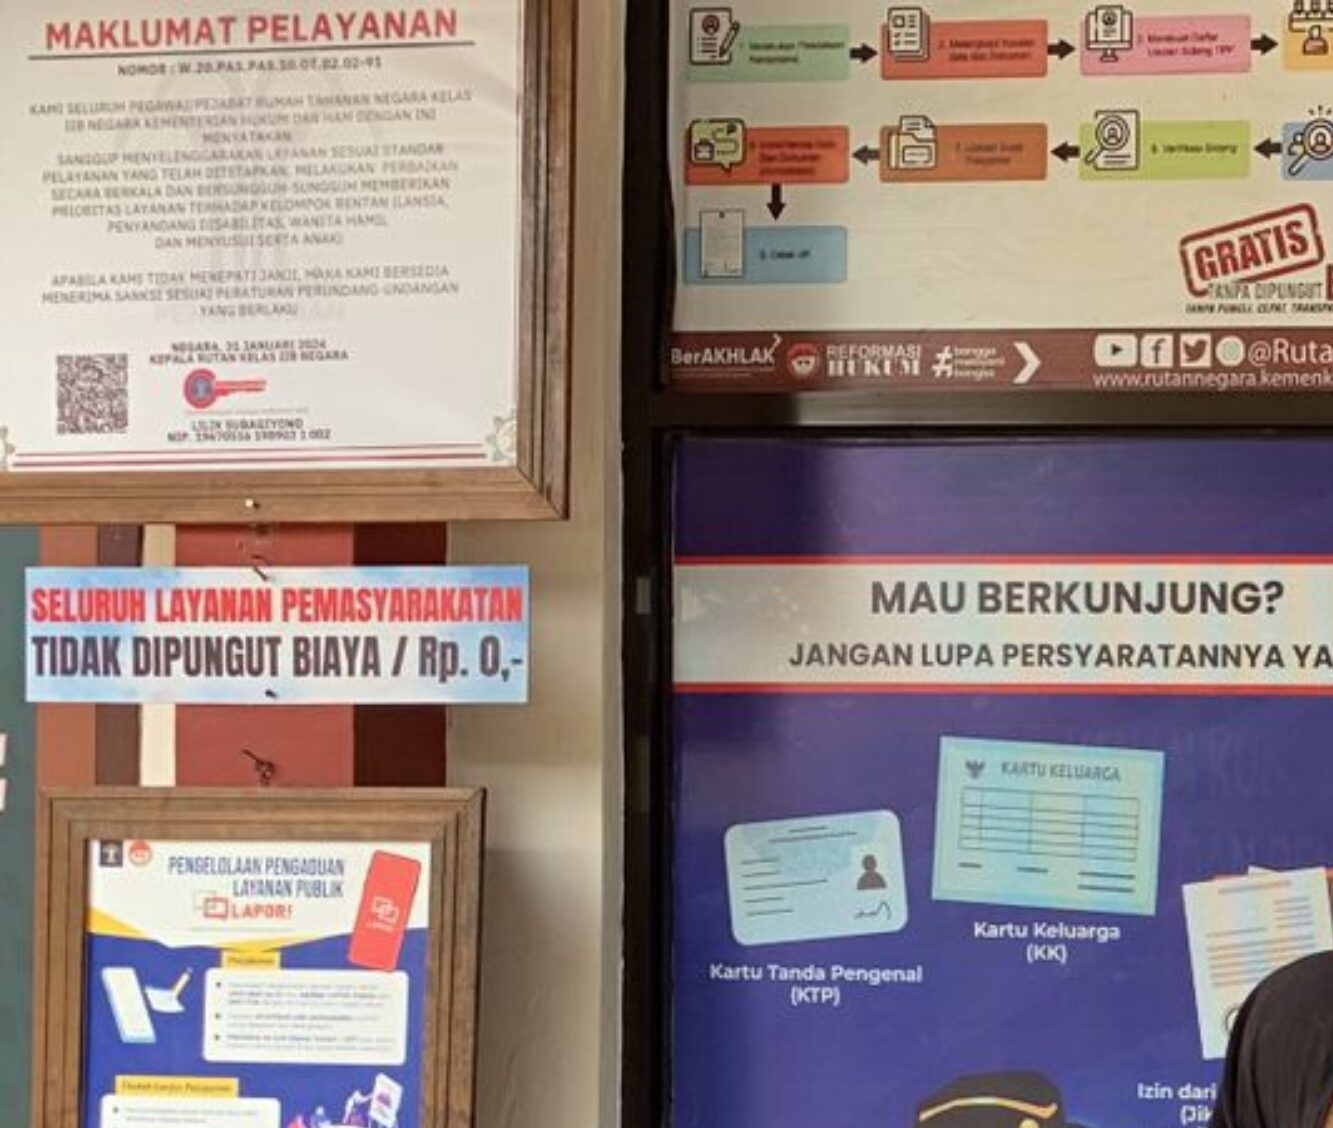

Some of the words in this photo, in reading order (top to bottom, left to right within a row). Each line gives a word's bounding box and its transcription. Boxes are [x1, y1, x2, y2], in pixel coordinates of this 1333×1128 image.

[47, 16, 236, 49] MAKLUMAT
[248, 10, 456, 43] PELAYANAN
[1194, 219, 1310, 282] GRATIS
[1256, 283, 1322, 298] DIPUNGUT
[671, 347, 775, 365] BerAKHLAK
[826, 344, 921, 361] REFORMASI
[32, 588, 146, 622] SELURUH
[155, 587, 272, 622] LAYANAN
[282, 587, 523, 622] PEMASYARAKATAN
[872, 581, 965, 614] MAU
[978, 581, 1284, 614] BERKUNJUNG?
[32, 636, 121, 676] TIDAK
[132, 636, 281, 677] DIPUNGUT
[293, 636, 381, 677] BIAYA
[392, 636, 408, 677] /
[419, 636, 468, 683] Rp.
[789, 643, 912, 667] JANGAN
[922, 643, 994, 667] LUPA
[1003, 644, 1285, 668] PERSYARATANNYA
[1001, 761, 1046, 778] KARTU
[1050, 764, 1121, 782] KELUARGA
[168, 856, 262, 875] PENGELOLAAN
[265, 857, 344, 876] PENGADUAN
[233, 880, 292, 897] LAYANAN
[296, 879, 343, 898] PUBLIK
[231, 904, 294, 920] LAPOR!
[975, 922, 1024, 939] Kartu
[1033, 922, 1120, 943] Keluarga
[1027, 943, 1067, 964] (KK)
[710, 964, 763, 980] Kartu
[767, 965, 826, 981] Tanda
[831, 965, 922, 985] Pengenal
[791, 986, 840, 1006] (KTP)
[1138, 1082, 1173, 1099] Izin
[1177, 1083, 1216, 1100] dari
